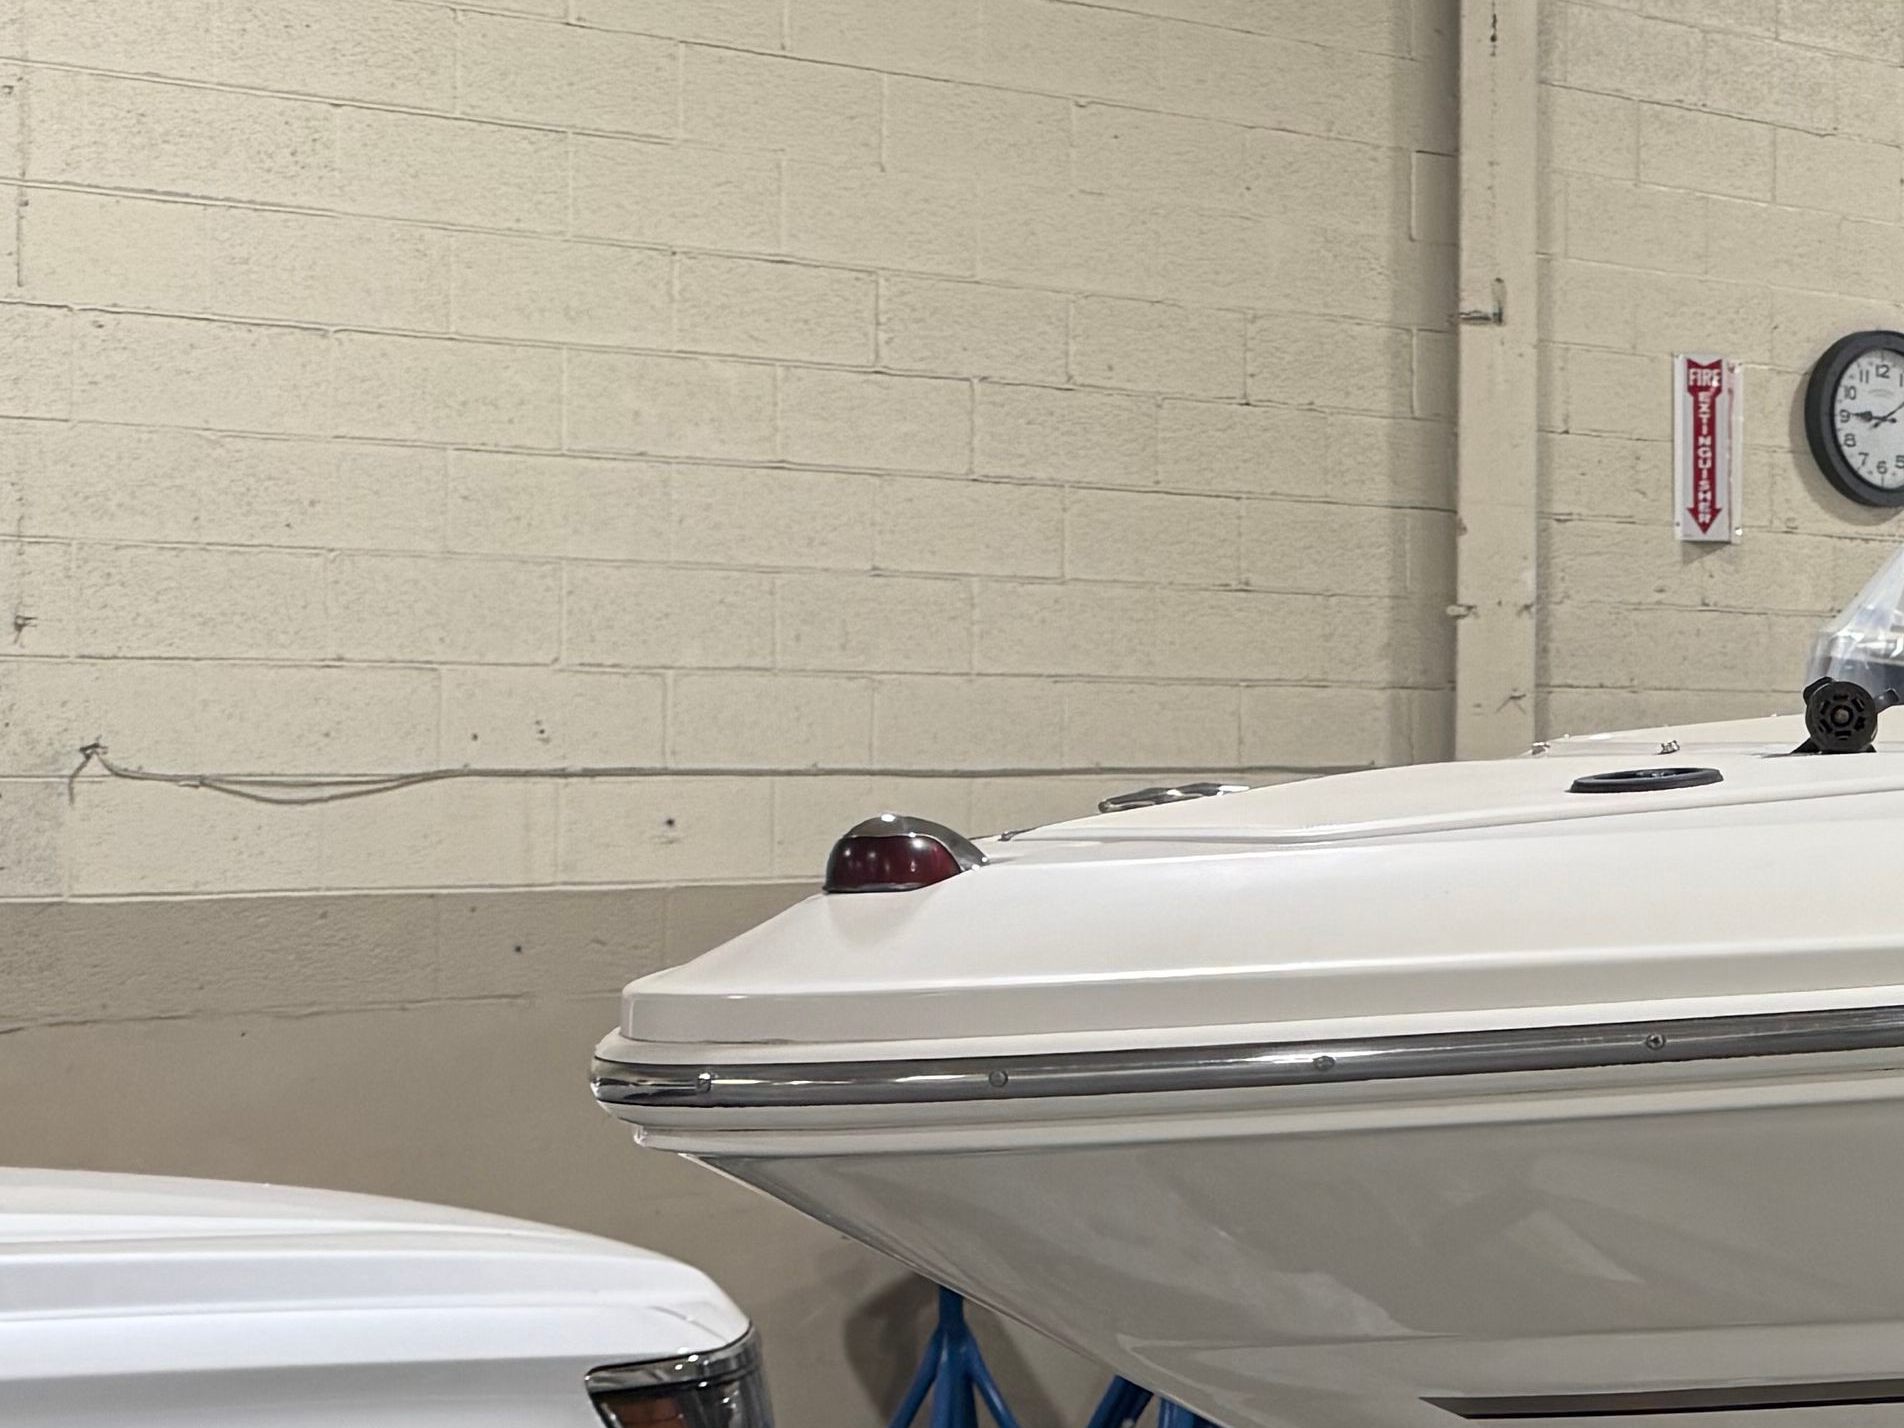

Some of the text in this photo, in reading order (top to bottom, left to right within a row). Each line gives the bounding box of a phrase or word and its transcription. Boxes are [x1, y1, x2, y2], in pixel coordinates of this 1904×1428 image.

[1688, 368, 1721, 387] FIRE
[1859, 369, 1870, 384] 11
[1875, 364, 1890, 379] 12
[1844, 385, 1857, 400] 10
[1839, 409, 1850, 423] 9
[1844, 433, 1857, 448] 8
[1697, 392, 1713, 524] EXTINGUISHER
[1858, 452, 1869, 467] 7
[1876, 460, 1888, 475] 6
